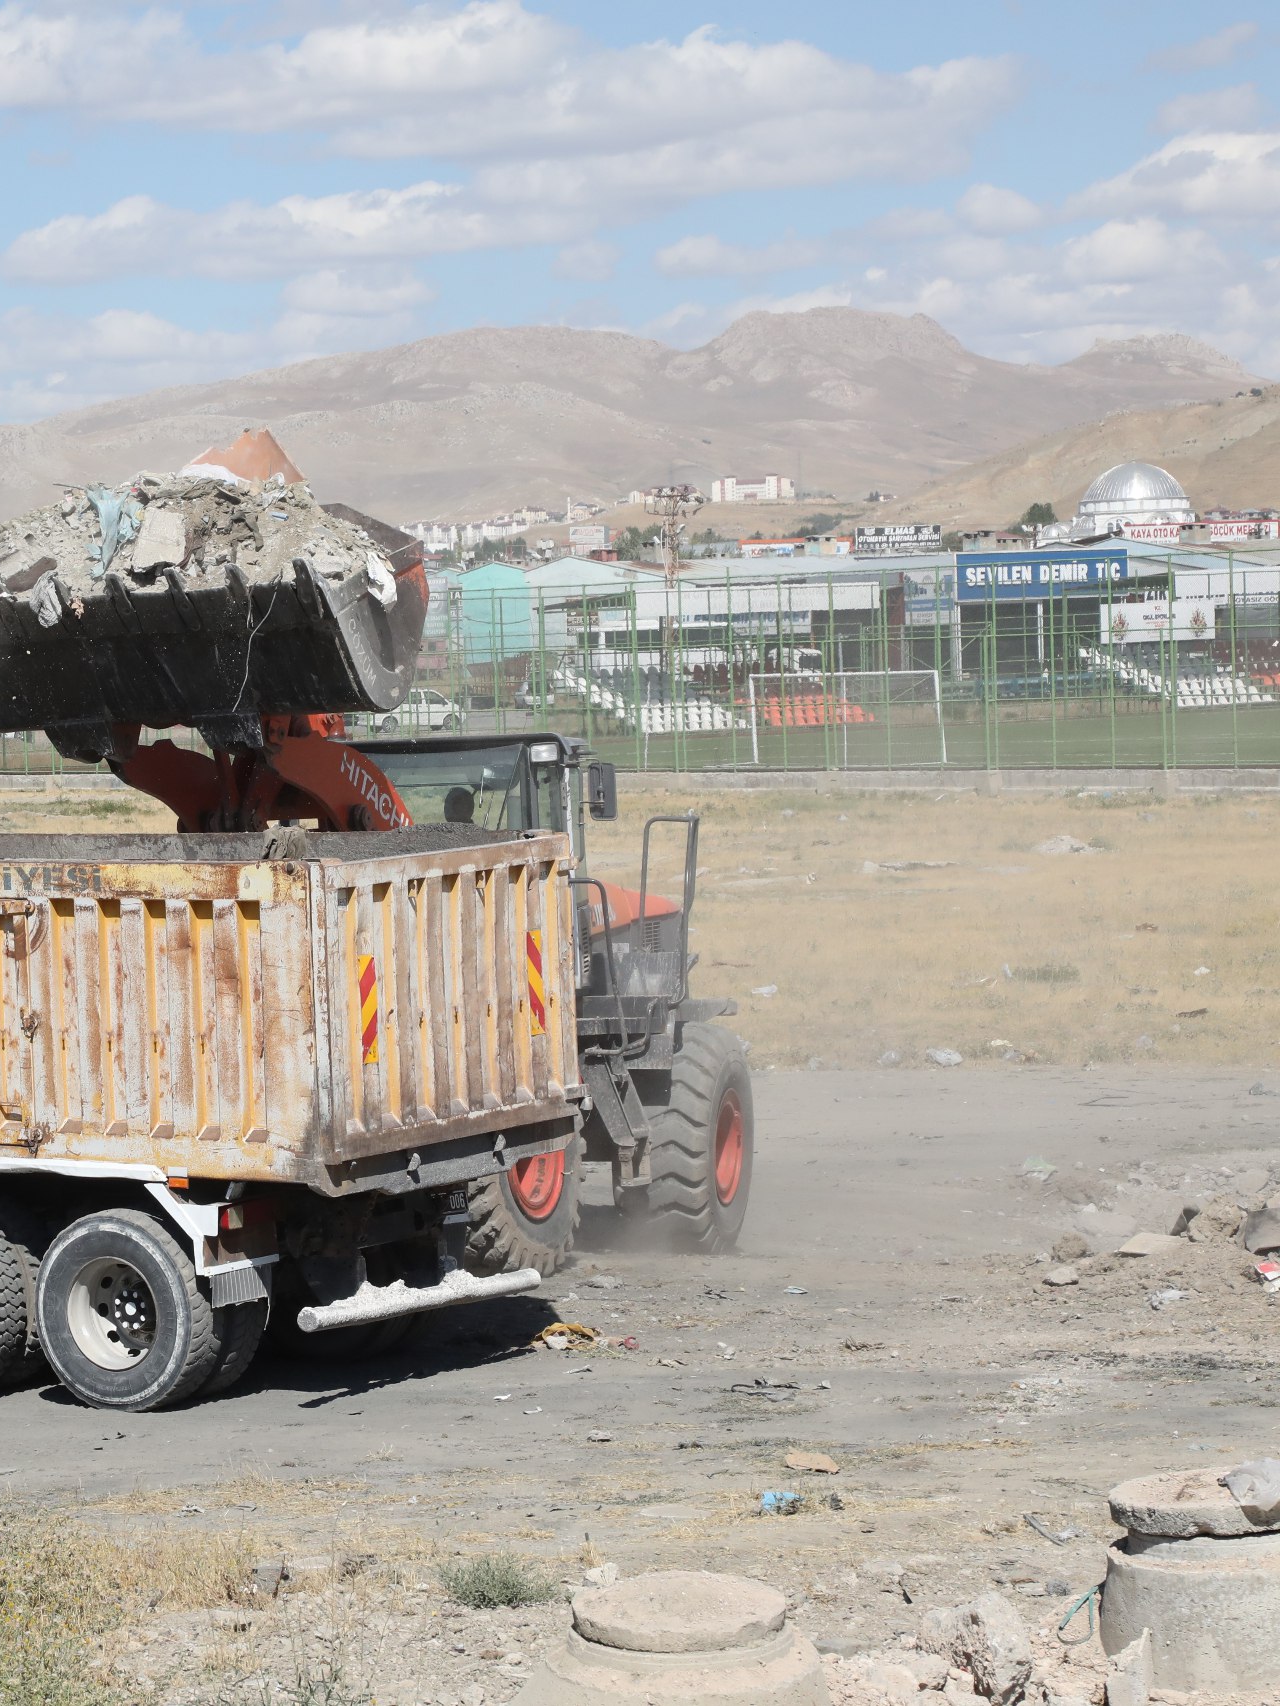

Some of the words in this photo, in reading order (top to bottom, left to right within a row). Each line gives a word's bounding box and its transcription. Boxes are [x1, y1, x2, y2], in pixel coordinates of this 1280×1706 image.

[884, 526, 915, 535] ELMAS
[1131, 528, 1151, 539] KAYA
[1153, 527, 1168, 538] OTO
[1039, 560, 1088, 584] DEMİR
